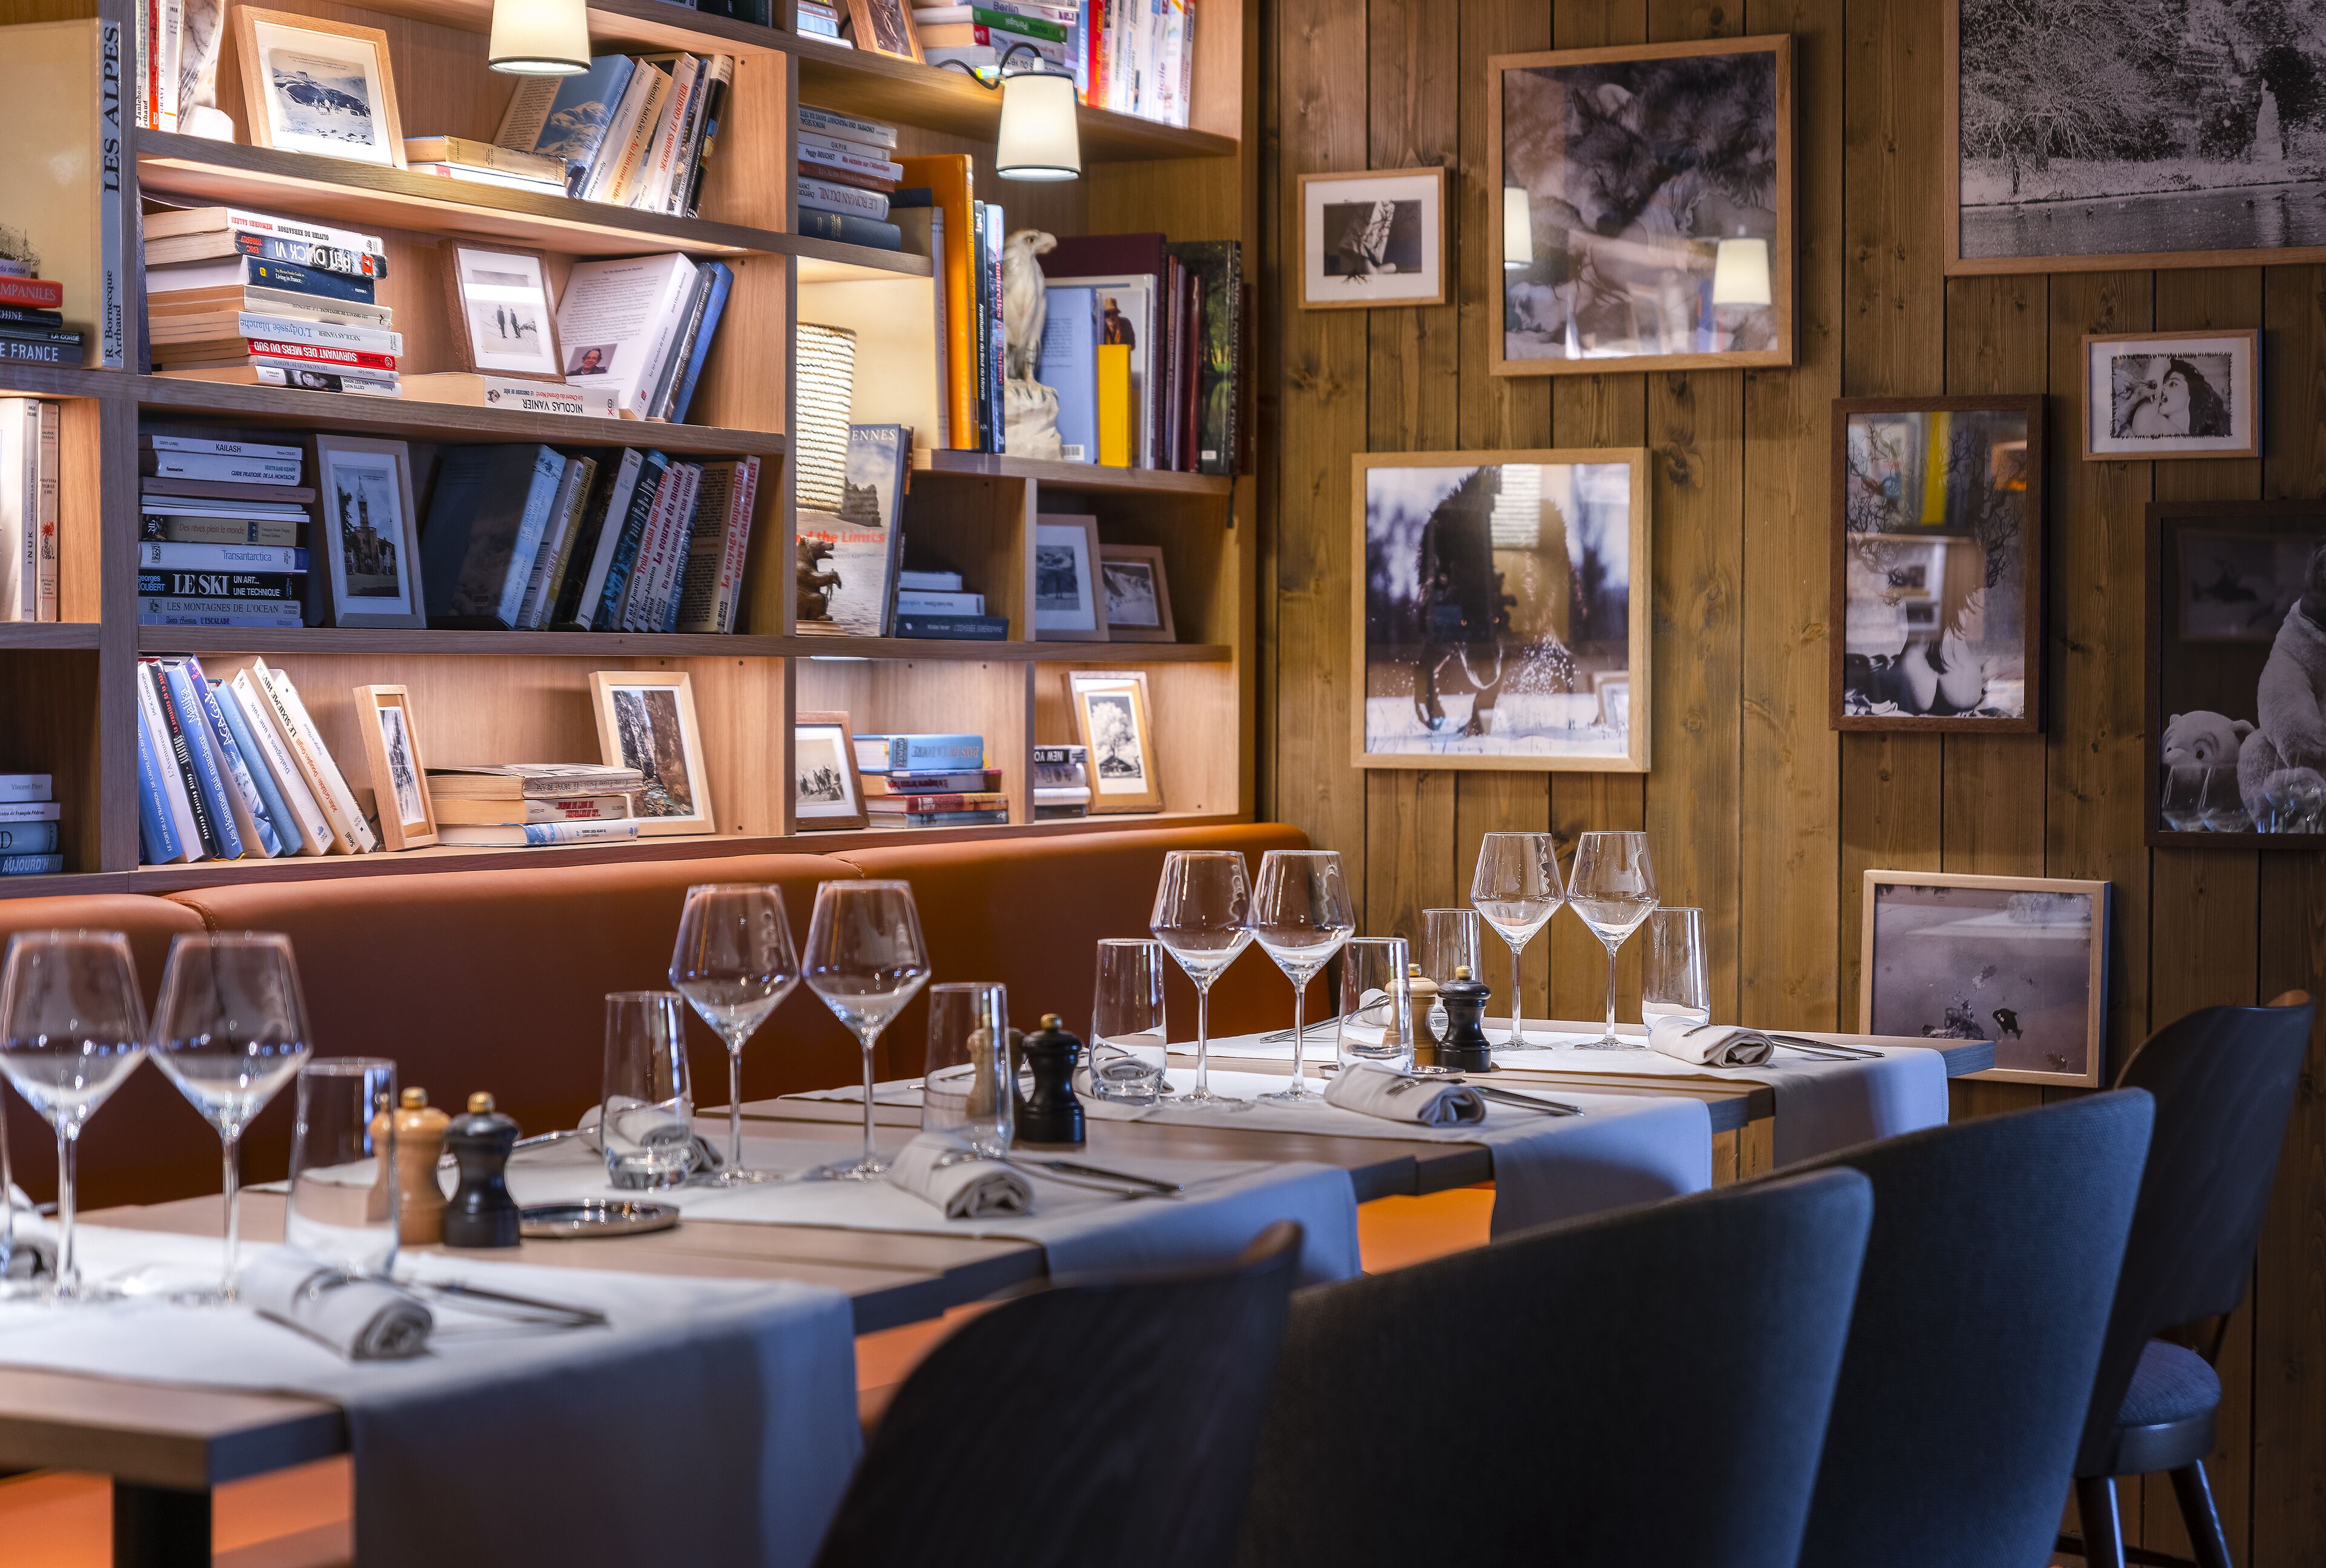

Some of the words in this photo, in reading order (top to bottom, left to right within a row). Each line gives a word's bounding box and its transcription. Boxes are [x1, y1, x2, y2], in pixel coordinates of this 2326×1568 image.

[993, 1, 1019, 14] Berlin
[1079, 28, 1087, 78] Japan
[104, 27, 119, 129] ALPES
[646, 76, 663, 105] valentin
[660, 131, 674, 171] SECOUONS
[669, 119, 677, 134] LE
[673, 83, 689, 119] COCOTIER
[831, 141, 847, 151] OKPIK
[806, 148, 817, 158] Peggy
[818, 151, 835, 160] BOUCHET
[104, 138, 119, 193] LES
[619, 165, 629, 180] une
[611, 181, 624, 200] voile
[819, 187, 832, 201] NIL
[832, 190, 843, 204] DU
[844, 191, 868, 208] ROMAN
[869, 197, 878, 210] LE
[277, 225, 303, 237] KERSAUSON
[240, 236, 262, 246] TABARLY
[246, 245, 259, 254] ERIC
[274, 241, 287, 258] VI
[8, 265, 26, 274] monde
[0, 283, 56, 301] MPANILES
[993, 262, 1004, 317] naturelles
[105, 270, 114, 339] Bornecque
[113, 305, 122, 359] Arthaud
[240, 318, 272, 332] blanche
[273, 322, 312, 337] L'Odyssée
[319, 329, 341, 340] VANIER
[341, 333, 360, 342] NICOLAS
[11, 343, 58, 362] FRANCE
[105, 345, 113, 359] R.
[254, 341, 270, 351] SUD
[270, 343, 280, 352] DU
[281, 343, 302, 356] MERS
[303, 347, 319, 357] DES
[320, 349, 357, 362] SURVIVANT
[980, 366, 985, 375] du
[996, 351, 1004, 385] Suisse
[521, 399, 550, 411] VANIER
[551, 401, 583, 414] NICOLAS
[849, 428, 896, 442] ENNES
[1228, 409, 1236, 459] FRANCE
[216, 443, 241, 453] KAILASH
[667, 469, 684, 501] monde
[681, 471, 695, 497] victoire
[572, 489, 586, 514] Alberto
[653, 491, 664, 507] nous
[679, 497, 688, 511] une
[740, 462, 757, 538] CARPENTIER
[664, 501, 676, 515] du
[649, 508, 661, 528] pour
[674, 511, 686, 529] pour
[179, 523, 190, 532] Des
[191, 523, 205, 532] rêves
[206, 524, 220, 535] plein
[227, 526, 245, 535] monde
[656, 517, 673, 550] course
[841, 529, 885, 544] Limits
[641, 528, 655, 553] océans
[668, 529, 681, 552] monde
[222, 549, 271, 561] Transantarctica
[652, 550, 664, 564] La
[666, 552, 675, 563] du
[724, 531, 737, 571] voyage
[545, 547, 560, 578] CORSE
[636, 553, 649, 575] Trois
[663, 563, 673, 578] tour
[172, 574, 195, 594] LE
[198, 574, 230, 595] SKI
[720, 574, 731, 589] Le
[247, 588, 280, 597] TECHNIQUE
[167, 603, 181, 611] LES
[184, 603, 230, 612] MONTAGNES
[233, 604, 244, 612] DE
[246, 604, 279, 613] L'OCEAN
[141, 673, 151, 699] LONDON
[148, 701, 157, 715] JACK
[178, 687, 197, 723] Malika
[249, 702, 260, 718] voix
[271, 691, 290, 726] SIXIEME
[259, 718, 268, 733] une
[288, 724, 297, 737] LE
[156, 729, 174, 776] L'Aventureuse
[173, 735, 189, 764] ALBATROS
[295, 737, 306, 754] Orgill
[961, 746, 979, 758] PAYS
[197, 734, 215, 775] marchent
[270, 738, 290, 774] Dialogues
[1046, 750, 1064, 762] NEW
[145, 761, 153, 779] L'AUTRE
[303, 753, 319, 777] Douglas
[210, 775, 221, 790] qui
[317, 778, 330, 799] Gribbin
[153, 792, 163, 815] TRAHISON
[216, 792, 233, 829] Hommes
[327, 798, 337, 813] John
[228, 829, 239, 845] Les
[344, 832, 356, 847] Seuil
